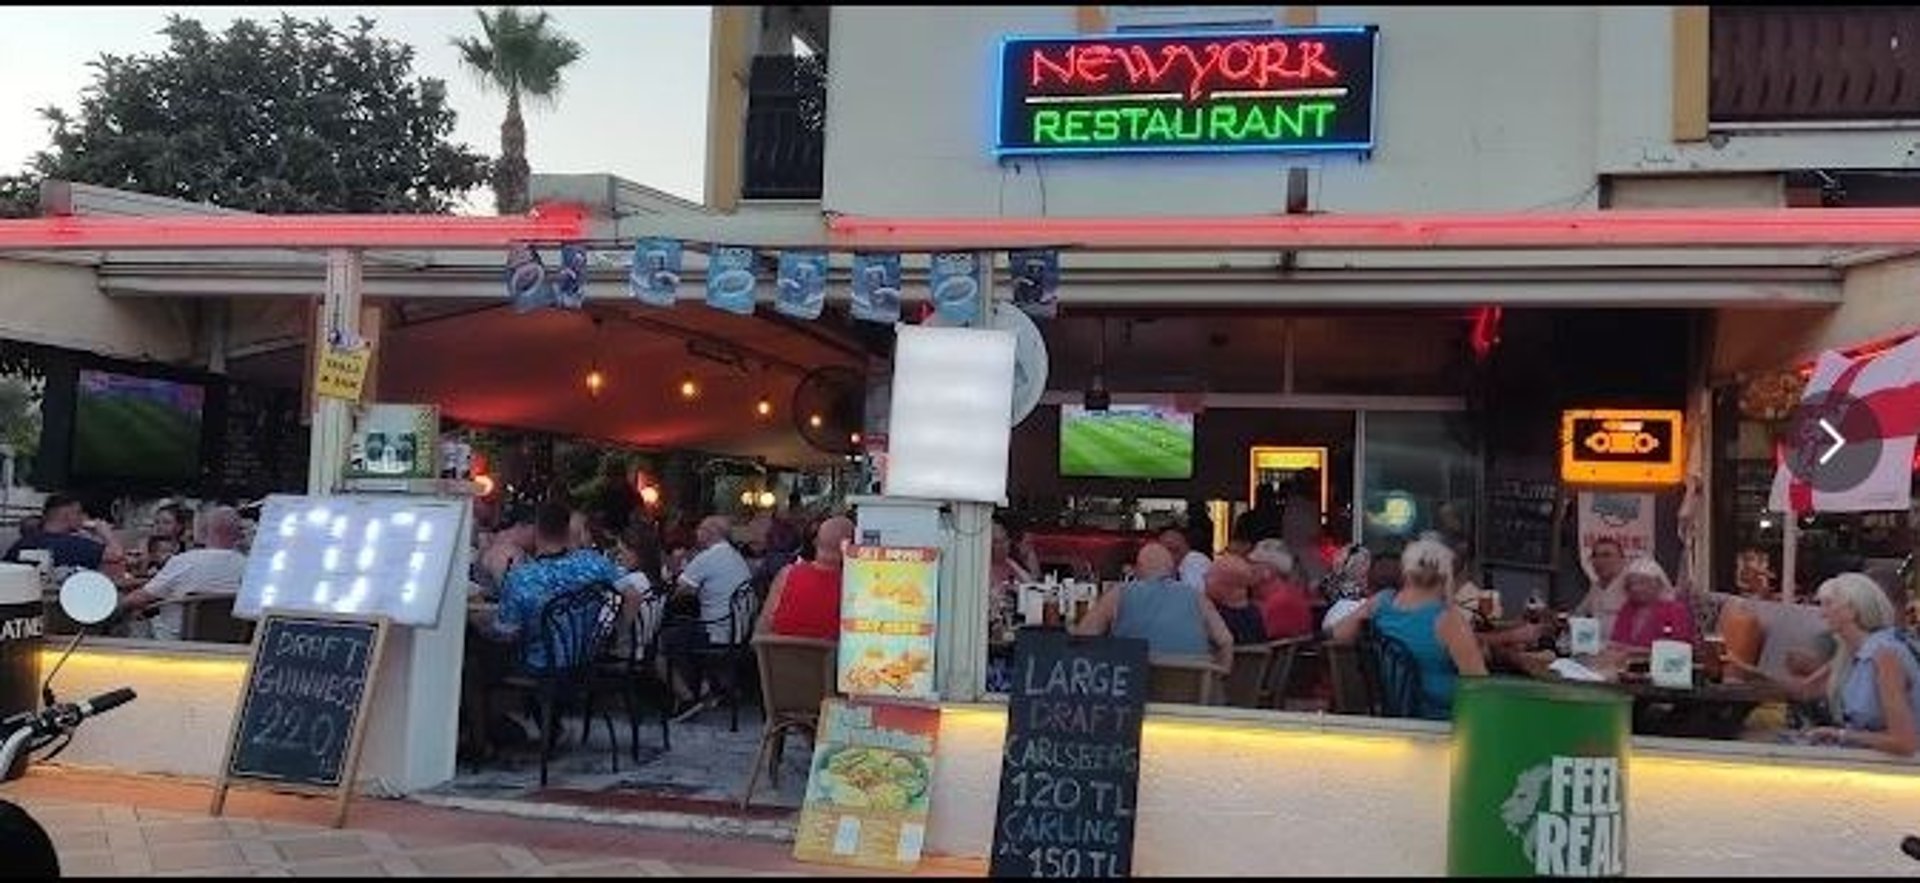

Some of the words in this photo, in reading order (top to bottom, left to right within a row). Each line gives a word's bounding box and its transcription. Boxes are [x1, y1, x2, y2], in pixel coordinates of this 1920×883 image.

[1033, 104, 1336, 143] RESTAURANT
[275, 631, 363, 669] DRAFT
[1025, 655, 1130, 696] LARGE
[1029, 702, 1132, 734] DRAFT
[1010, 771, 1082, 809] 120
[1090, 780, 1131, 816] TL
[1550, 756, 1620, 815] FEEL
[1003, 811, 1121, 844] CARLING
[1535, 811, 1622, 877] REAL
[1028, 847, 1081, 878] 150
[1088, 851, 1124, 878] TL
